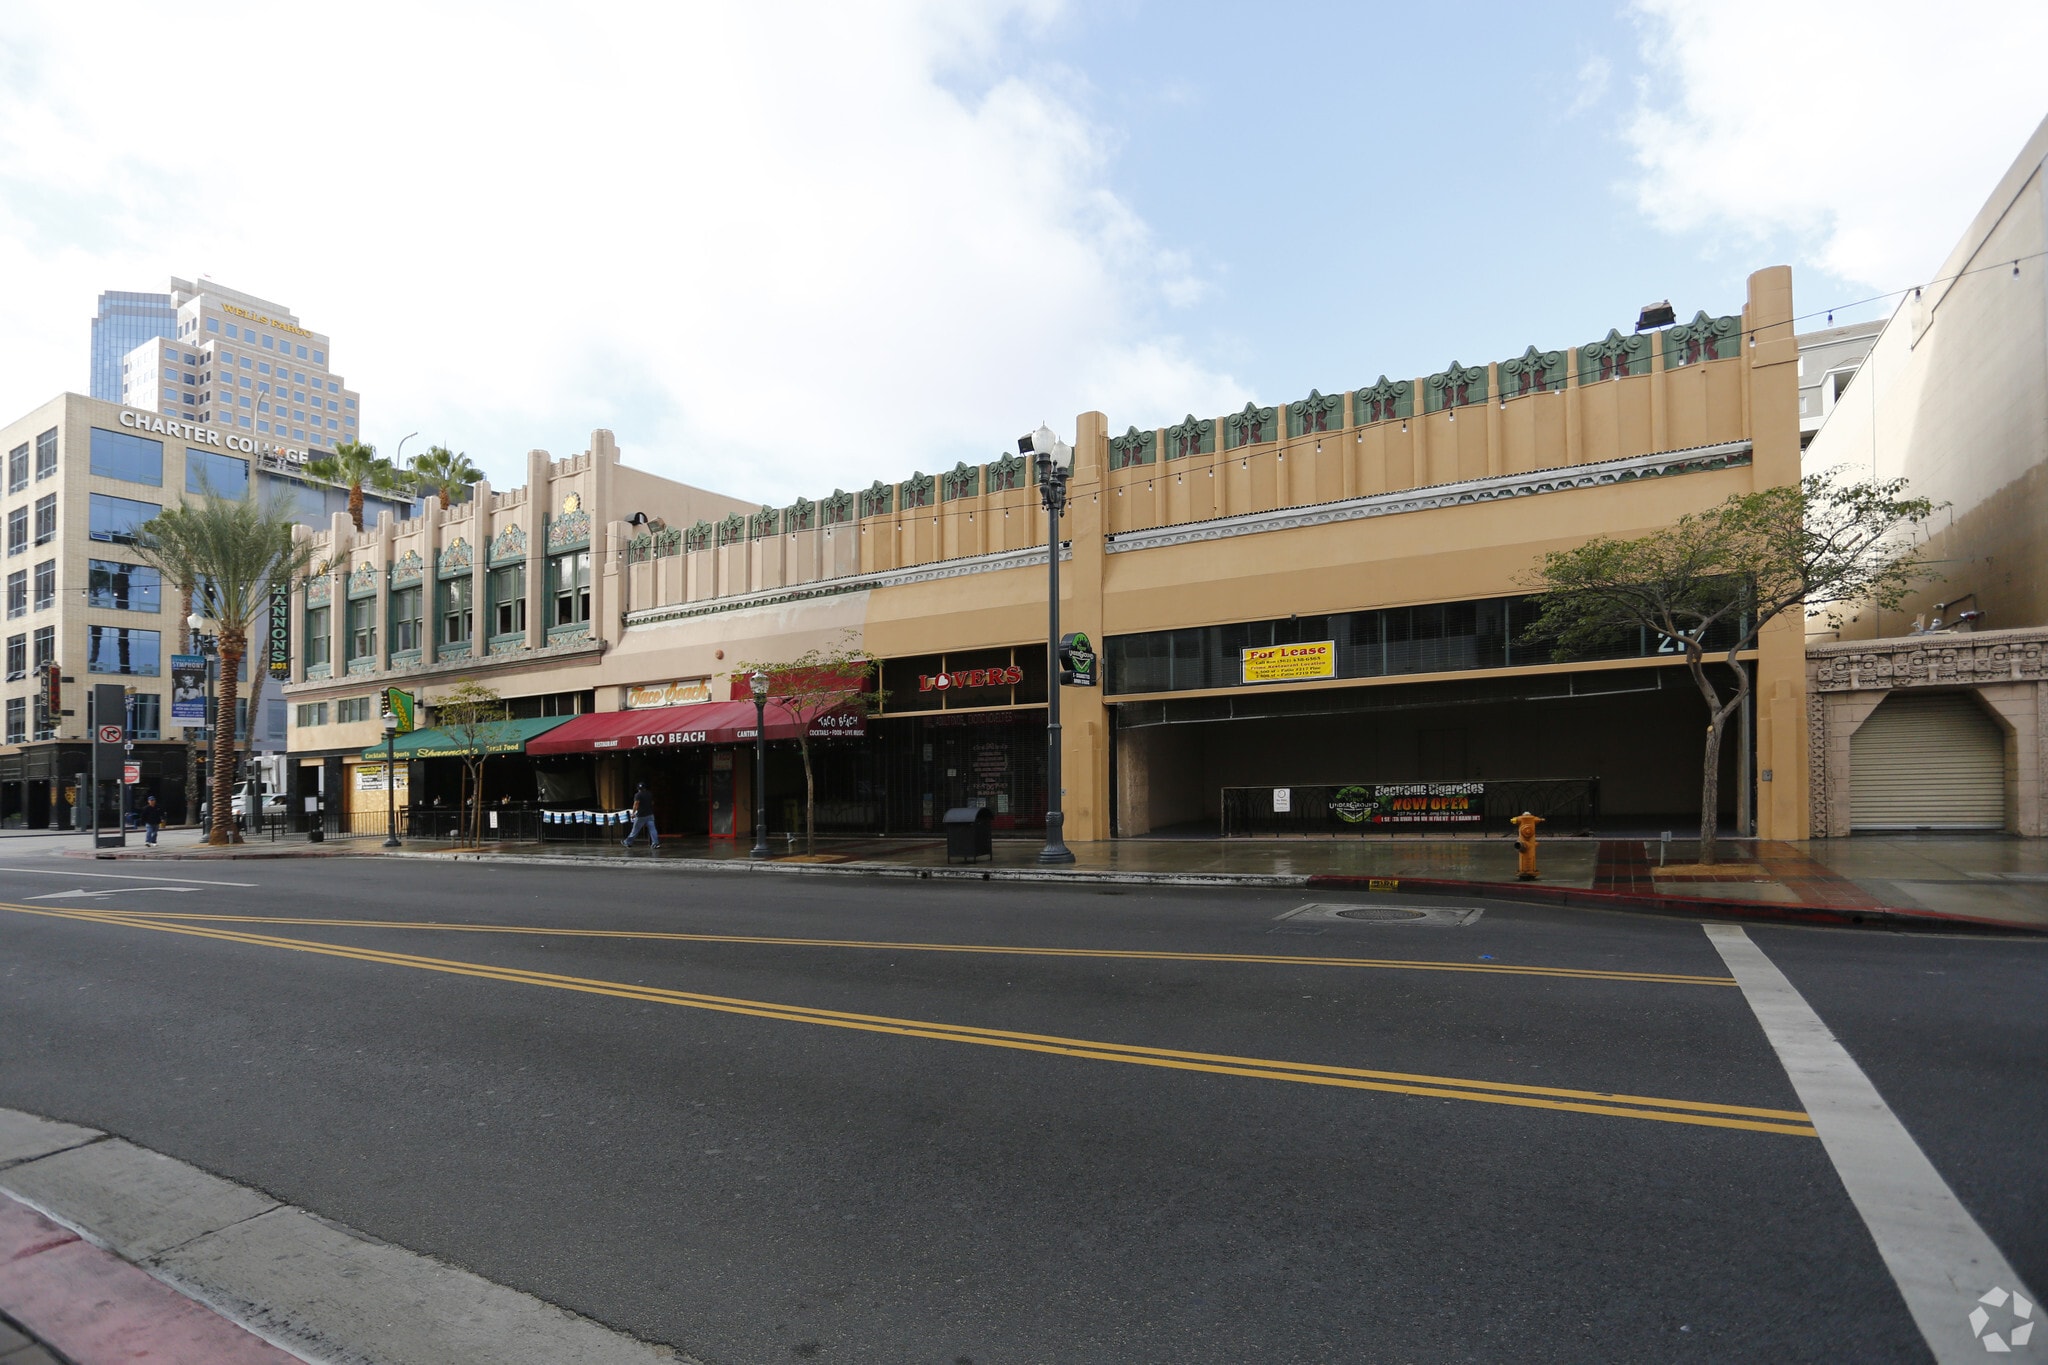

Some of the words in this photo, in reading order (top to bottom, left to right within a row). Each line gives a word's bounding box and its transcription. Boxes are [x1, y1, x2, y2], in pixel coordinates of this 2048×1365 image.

[221, 303, 269, 325] WELLS
[271, 319, 313, 339] FARGO
[119, 410, 220, 448] CHARTER
[271, 583, 288, 662] HANNONS
[1250, 650, 1275, 660] For
[1281, 646, 1326, 657] Lease
[270, 662, 287, 670] 201
[919, 665, 1021, 692] LOVERS
[41, 670, 50, 707] KINGS
[629, 686, 664, 707] Taco
[665, 679, 710, 701] Beach
[818, 715, 836, 728] TACO
[838, 713, 858, 728] BEACH
[636, 733, 665, 746] TACO
[668, 731, 706, 744] BEACH
[736, 730, 758, 738] CANTINA
[503, 743, 519, 751] Food
[365, 752, 388, 760] Cocktails
[393, 751, 410, 759] Sports
[1375, 784, 1427, 797] Electronic
[1428, 783, 1484, 797] Cigarettes
[1393, 798, 1428, 811] NOW
[1430, 797, 1469, 810] OPEN
